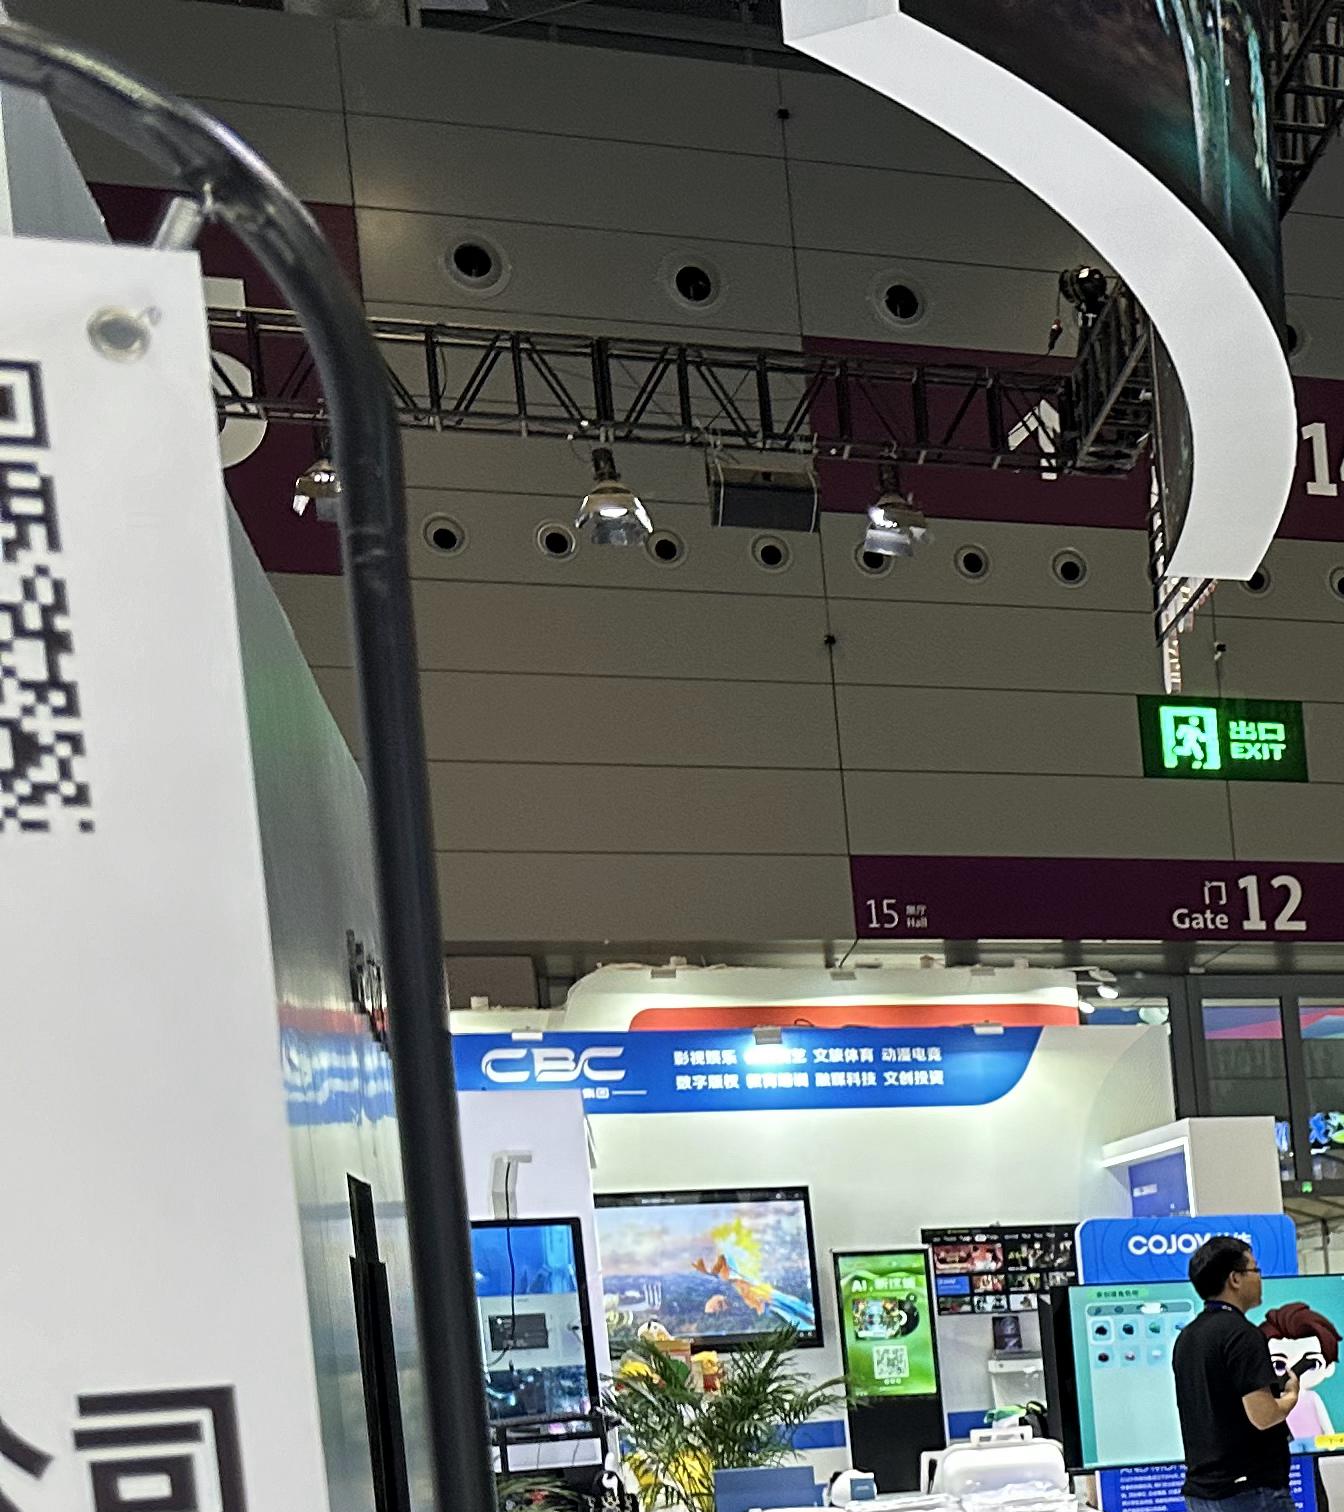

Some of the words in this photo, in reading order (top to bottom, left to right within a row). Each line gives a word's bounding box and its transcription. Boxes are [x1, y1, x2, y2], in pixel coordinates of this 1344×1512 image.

[1229, 720, 1286, 741] 出口
[1230, 741, 1287, 760] EXIT
[1172, 908, 1229, 930] Gate
[1238, 874, 1307, 931] 12
[1204, 881, 1228, 906] 门
[866, 898, 899, 929] 15
[906, 917, 928, 928] Hall
[481, 1046, 626, 1083] CBC
[1127, 1232, 1212, 1256] COJOY
